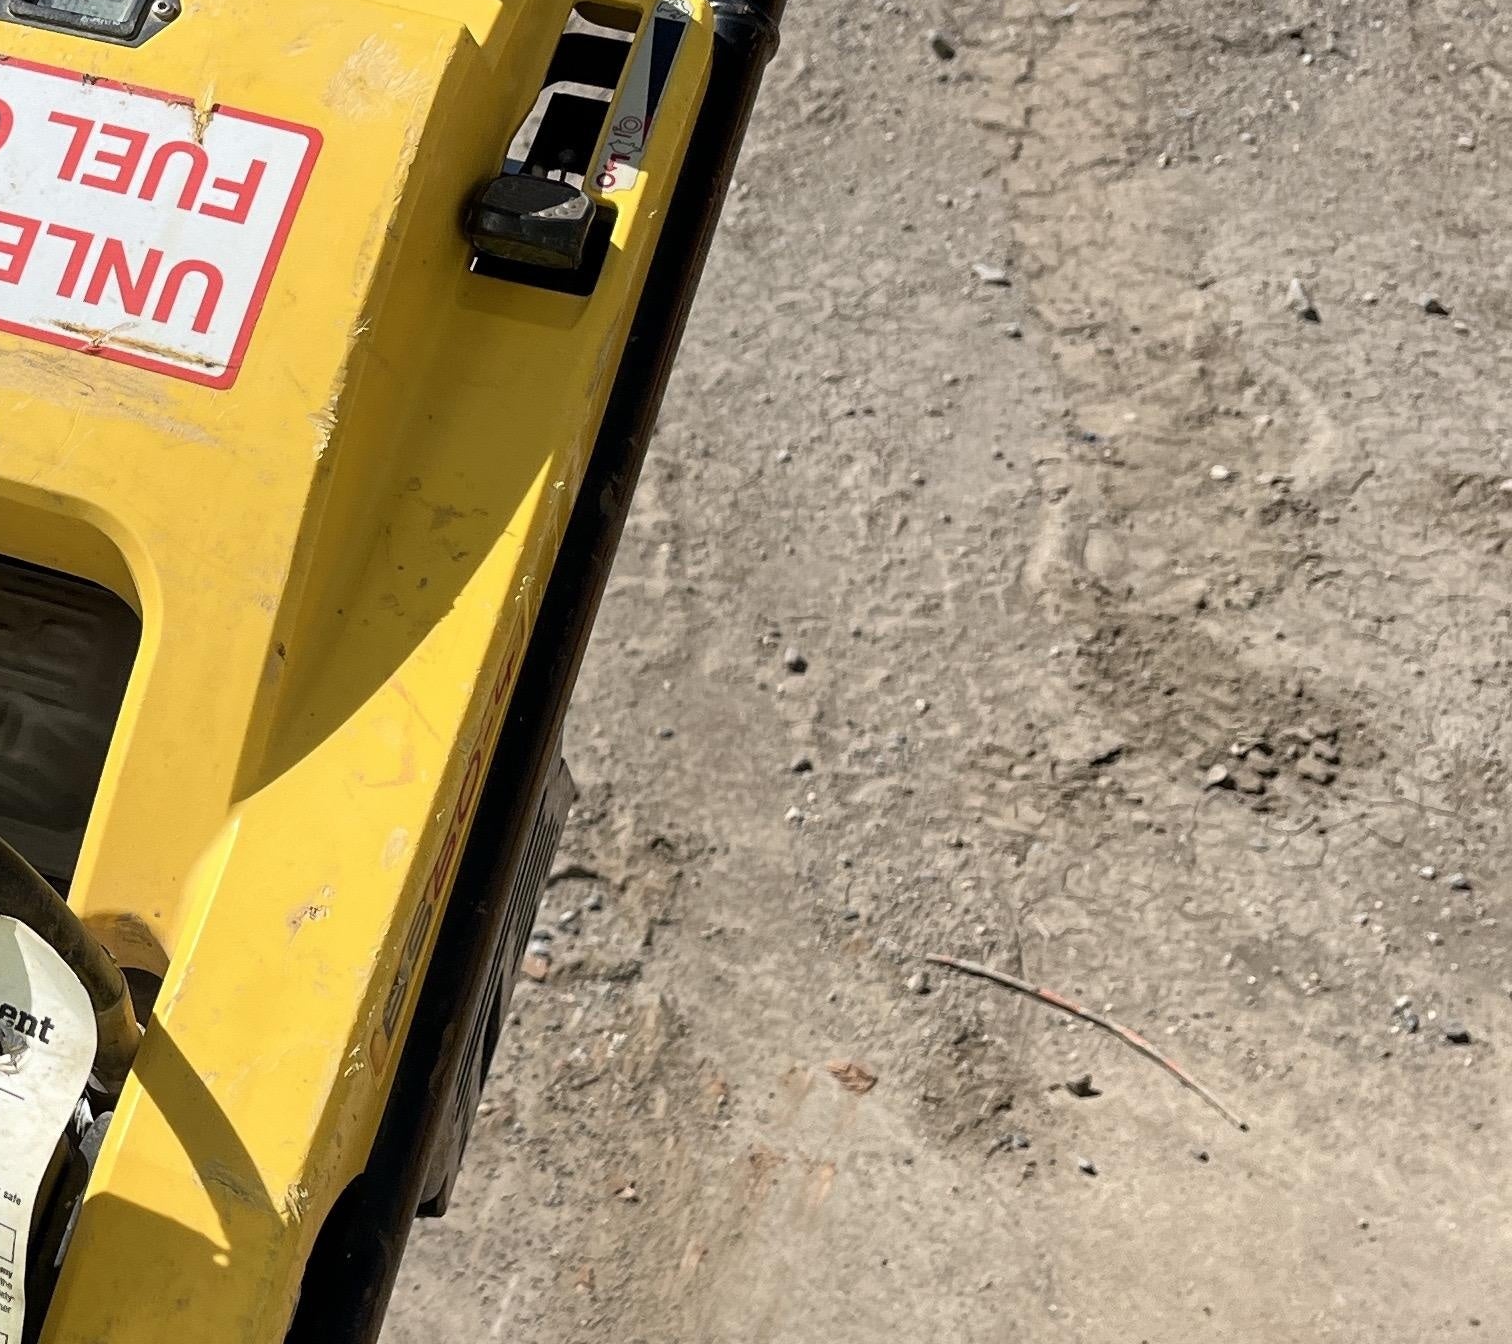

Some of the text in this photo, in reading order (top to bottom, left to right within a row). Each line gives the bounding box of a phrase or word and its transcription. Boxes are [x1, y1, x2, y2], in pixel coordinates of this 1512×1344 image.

[47, 111, 267, 225] FUEL
[3, 1191, 21, 1206] safe
[0, 1266, 13, 1279] my
